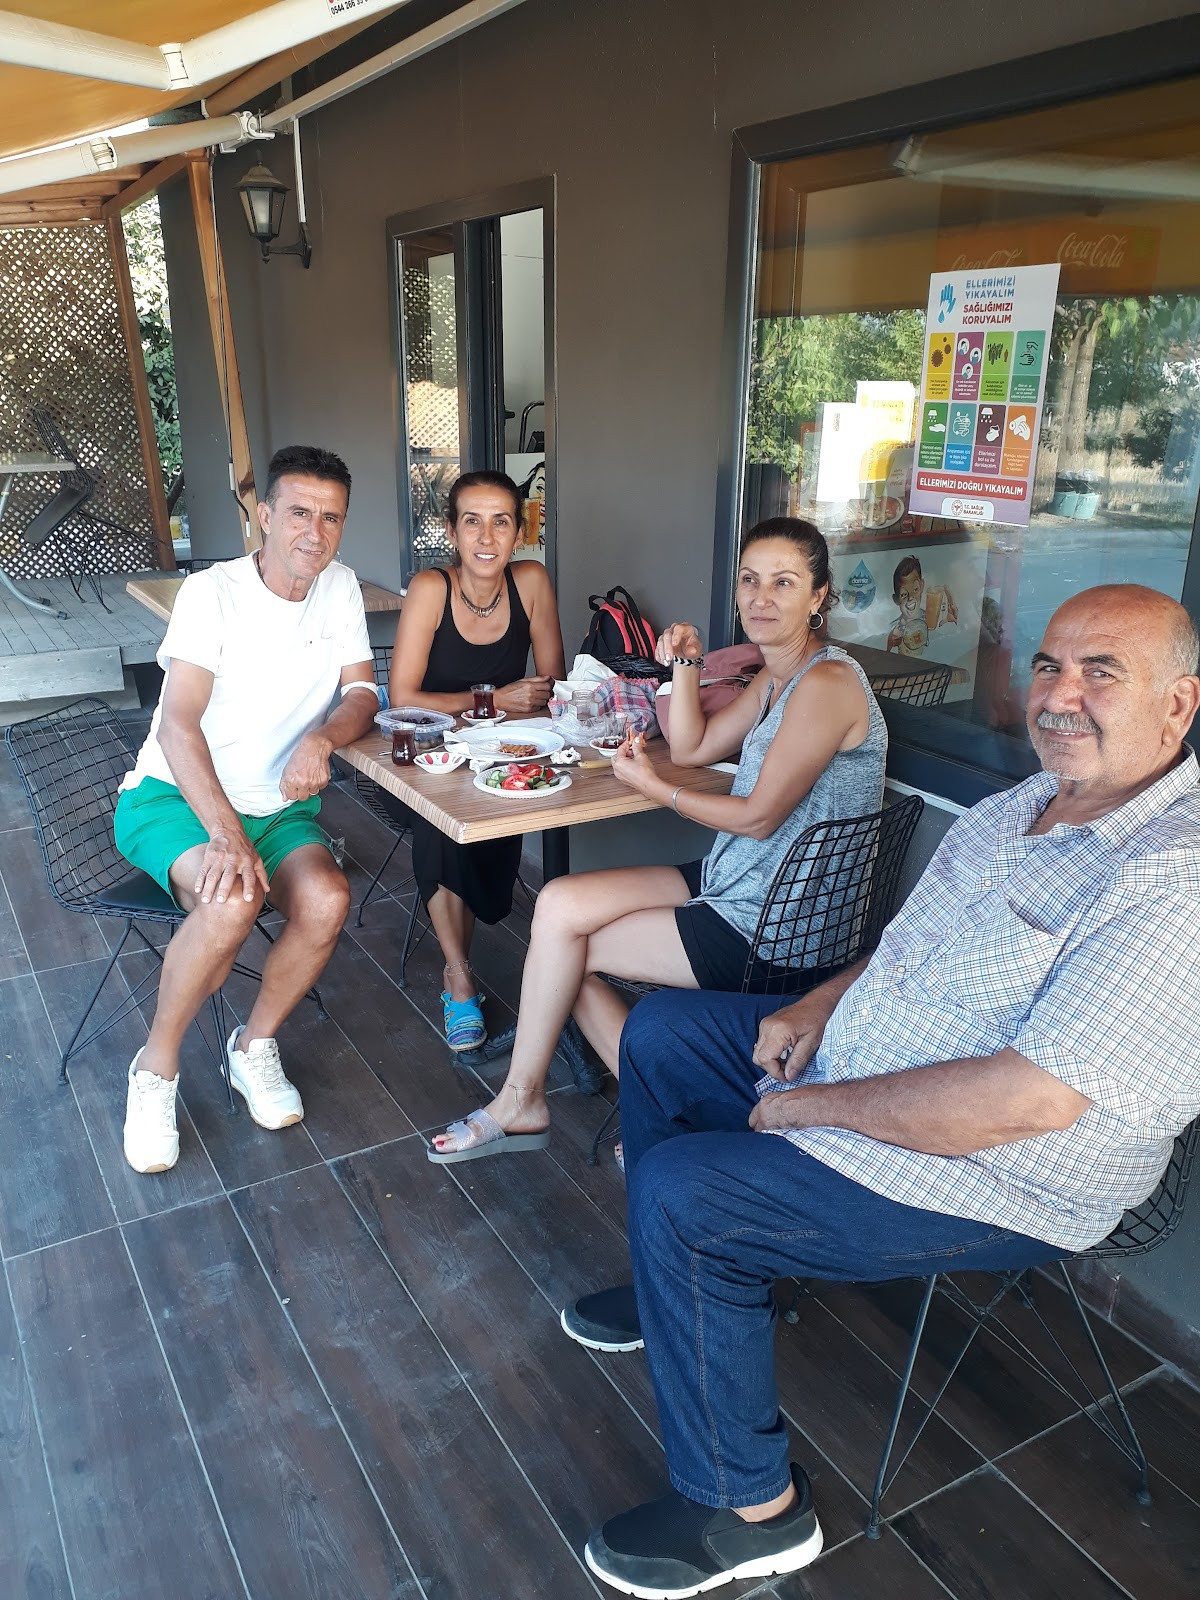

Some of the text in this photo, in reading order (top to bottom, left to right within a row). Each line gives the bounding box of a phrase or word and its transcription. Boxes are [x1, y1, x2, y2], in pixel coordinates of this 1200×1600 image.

[966, 275, 1016, 289] ELLERİMİZİ
[965, 289, 1015, 299] YIKAYALIM
[963, 301, 1013, 313] SAĞLIĞIMIZI
[962, 314, 1012, 325] KORUYALIM
[919, 477, 956, 489] ELLERİMİZİ
[957, 480, 983, 491] DOĞRU
[984, 483, 1023, 496] YIKAYALIM
